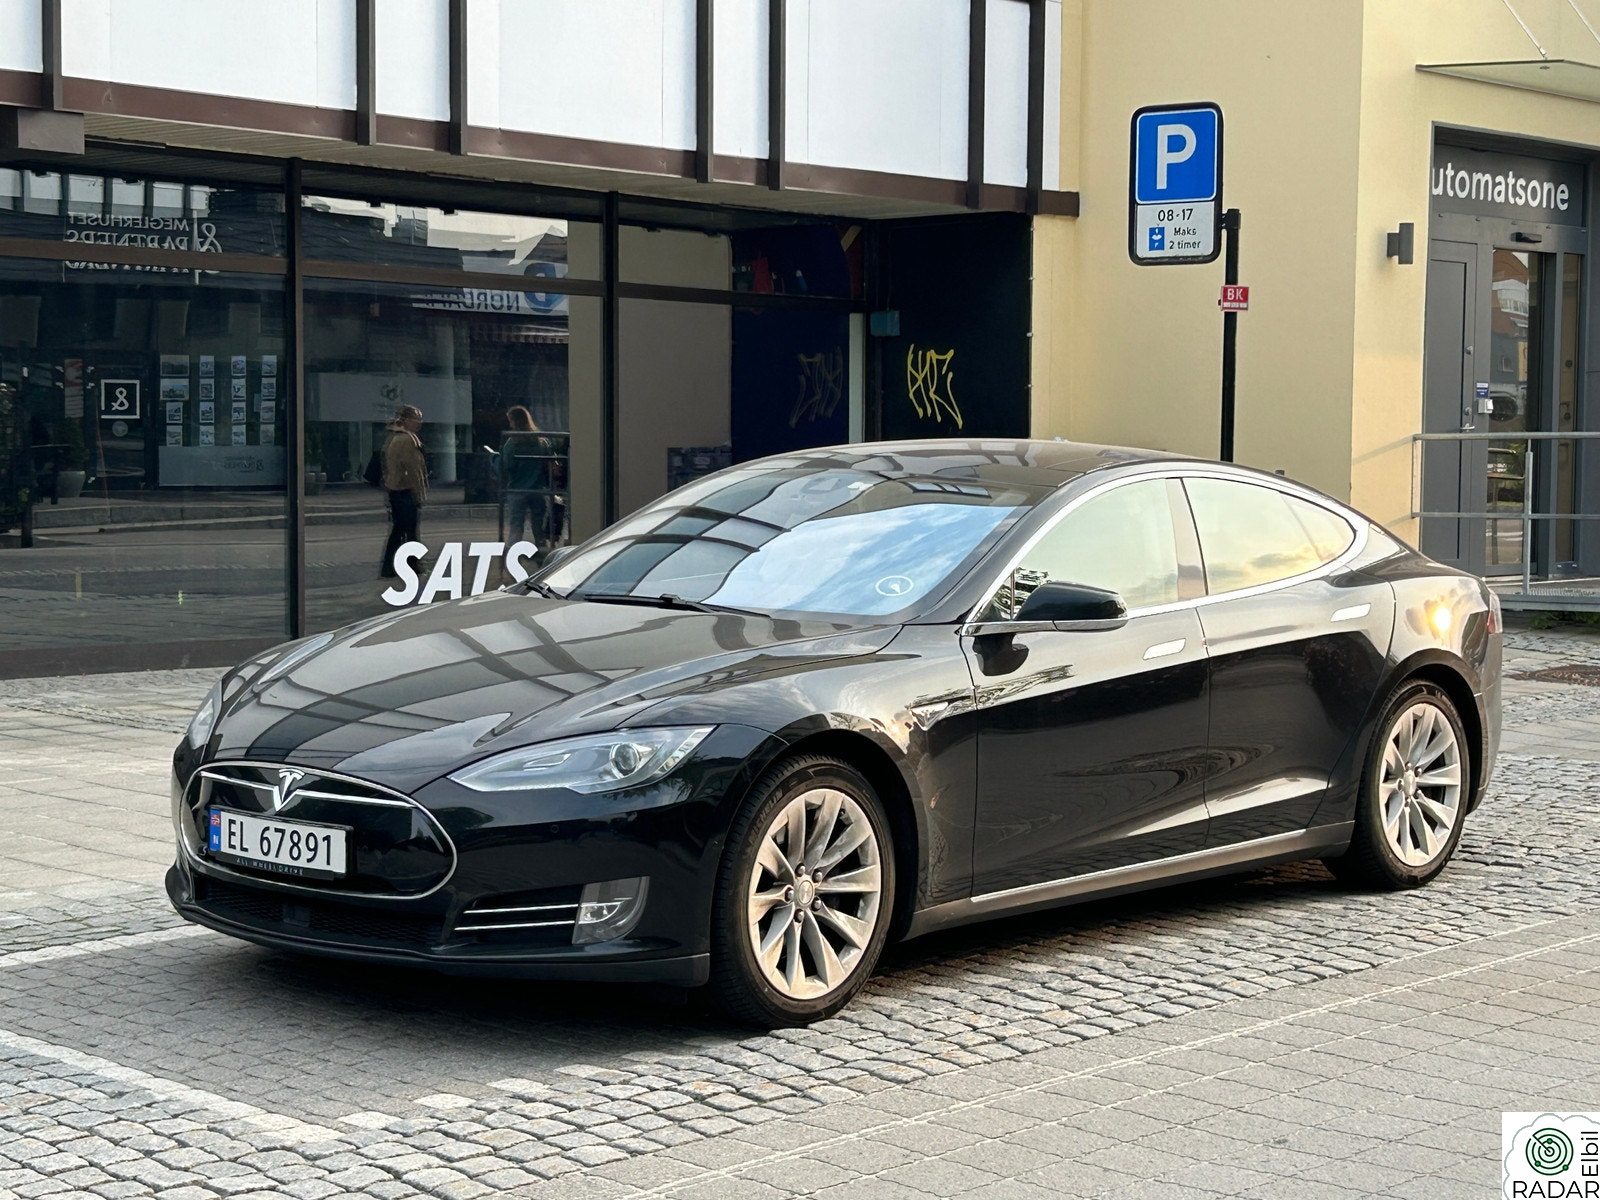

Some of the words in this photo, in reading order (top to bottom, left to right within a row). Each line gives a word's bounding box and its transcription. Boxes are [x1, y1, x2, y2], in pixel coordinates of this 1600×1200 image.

[1156, 123, 1197, 190] P
[1169, 240, 1176, 250] 2
[1177, 240, 1202, 249] timer
[1173, 227, 1197, 236] Maks
[1227, 288, 1244, 301] BK
[380, 540, 539, 606] SATS
[228, 818, 249, 852] EL
[260, 825, 332, 866] 67891
